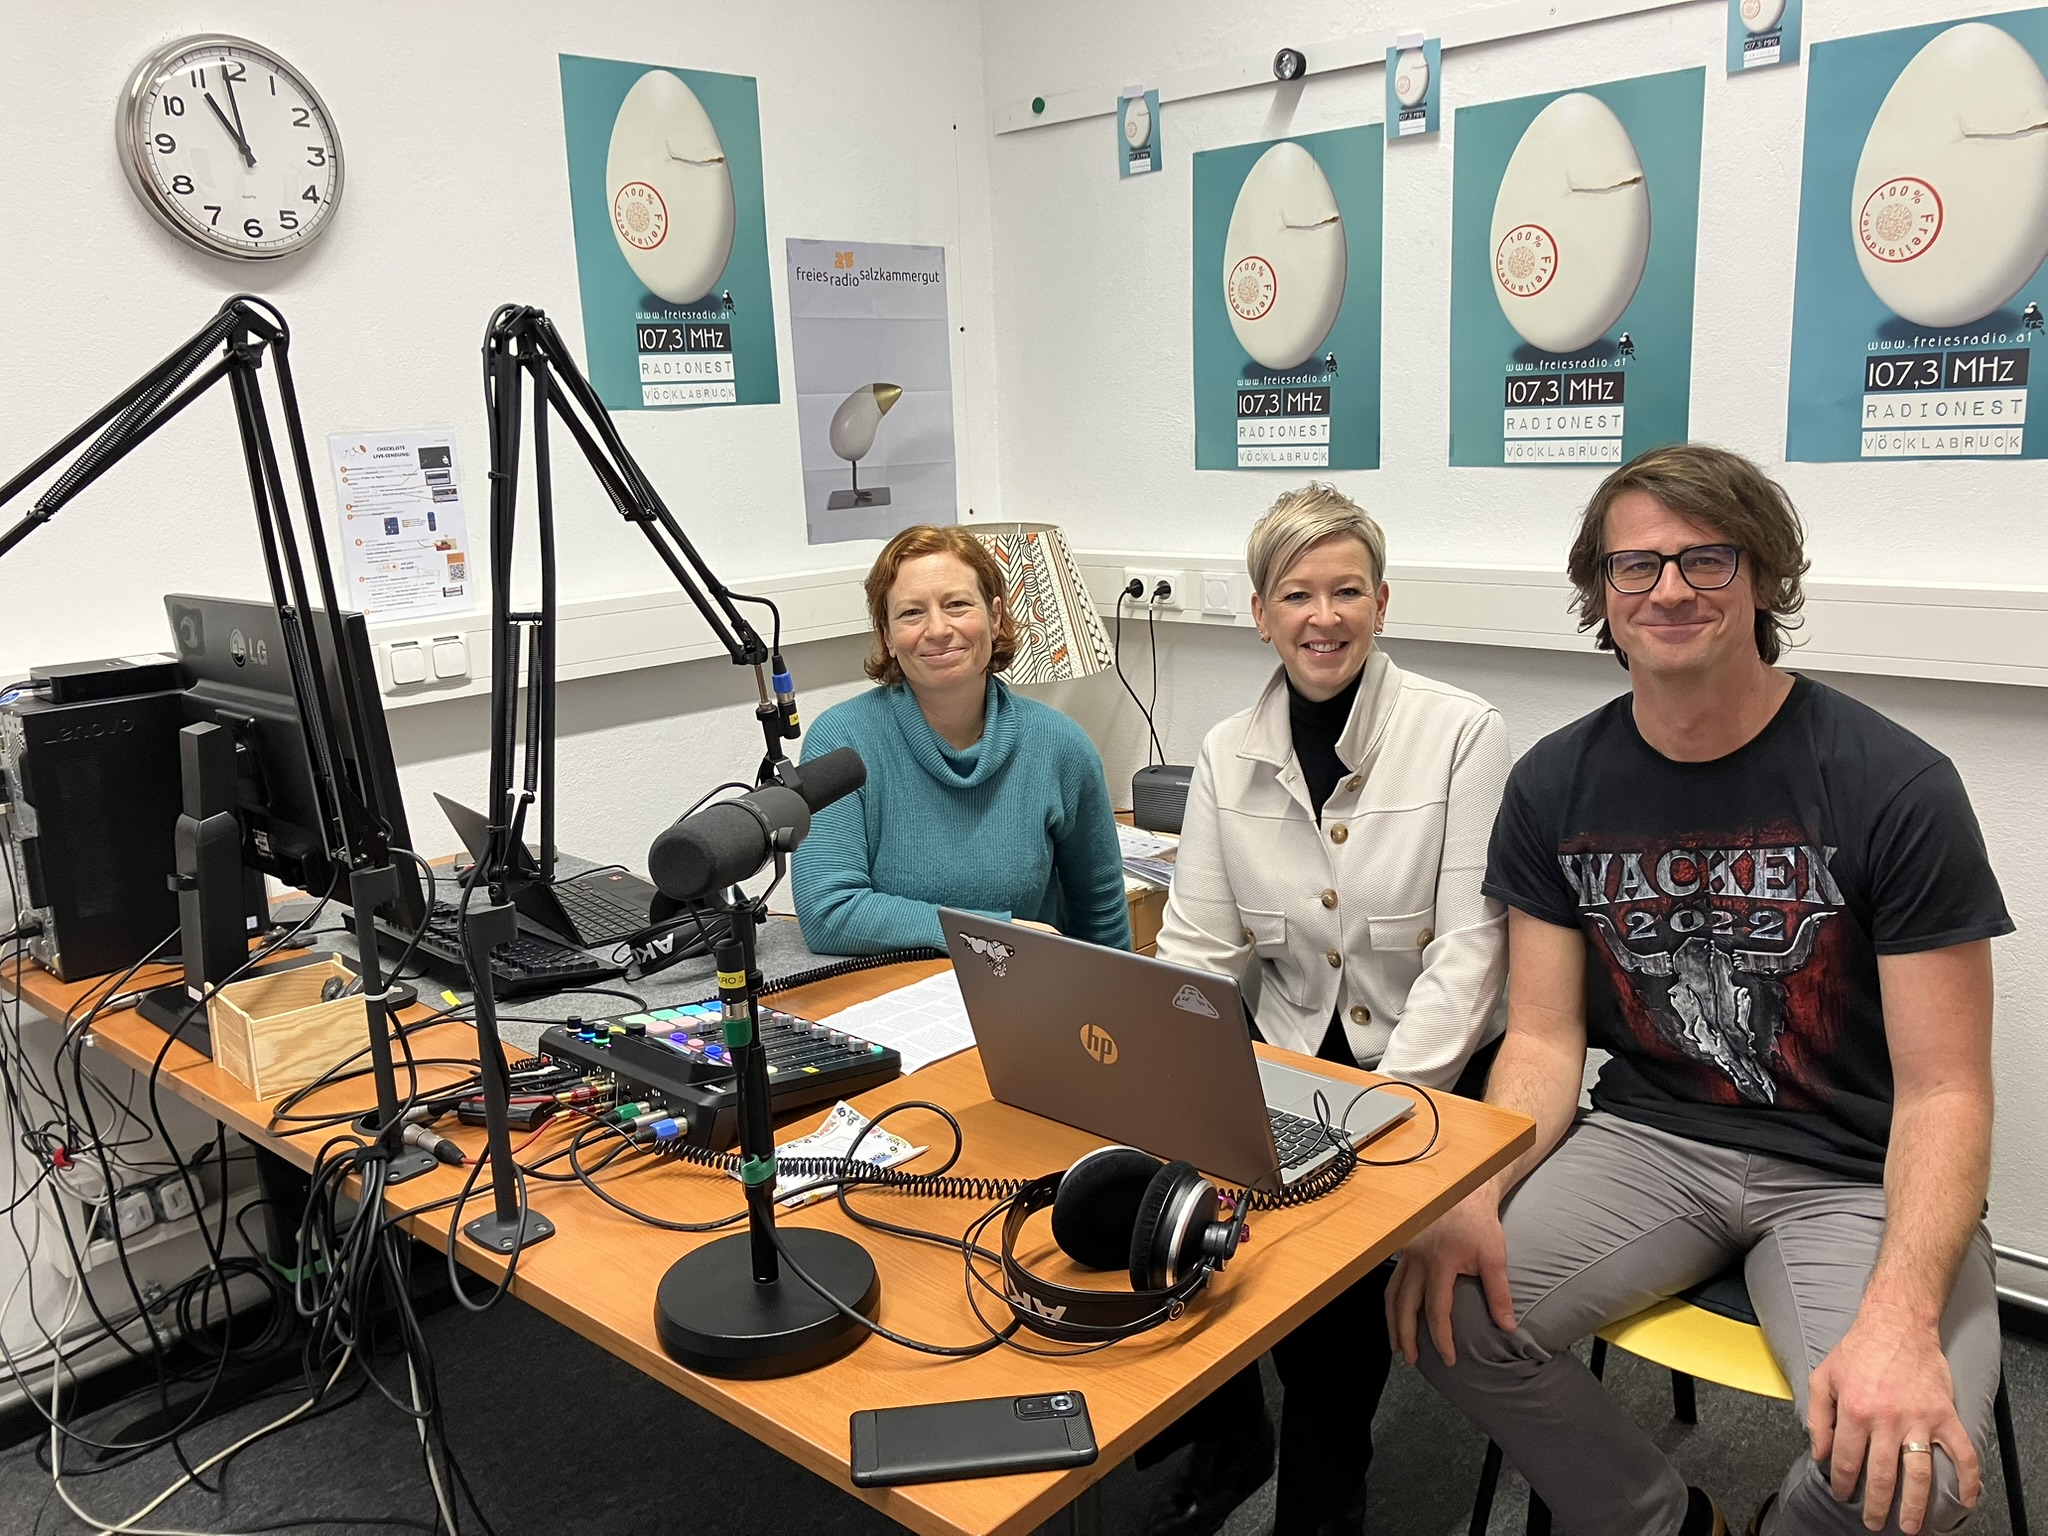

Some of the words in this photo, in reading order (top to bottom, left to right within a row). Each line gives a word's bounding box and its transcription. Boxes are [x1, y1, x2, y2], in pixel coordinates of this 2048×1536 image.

[190, 68, 206, 89] 11
[269, 75, 276, 96] 1
[163, 95, 185, 117] 10
[291, 107, 311, 128] 2
[154, 133, 176, 154] 9
[306, 146, 326, 167] 3
[172, 174, 195, 195] 8
[301, 184, 320, 204] 4
[1880, 185, 1925, 204] 100%
[624, 188, 654, 205] 100%
[203, 205, 222, 226] 7
[279, 209, 299, 230] 5
[243, 218, 264, 238] 6
[1510, 231, 1544, 248] 100%
[834, 251, 854, 270] 25
[1239, 262, 1266, 277] 100%
[796, 266, 829, 282] freies
[830, 273, 860, 287] radio
[859, 266, 940, 286] salzkammergut
[635, 309, 730, 320] www.freiesradio.at
[639, 328, 684, 352] 107,3
[690, 328, 725, 348] MHz
[1867, 332, 2033, 351] www.freiesradio.at
[641, 360, 732, 375] RADIONEST
[1505, 357, 1626, 372] www.freiesradio.at
[1867, 359, 1939, 390] 107,3
[1952, 356, 2015, 384] MHz
[1236, 374, 1332, 386] www.freiesradio.at
[643, 387, 735, 400] VÖCKLABRUCK
[1506, 380, 1560, 406] 107,3
[1569, 377, 1615, 401] MHz
[1239, 393, 1280, 416] 107,3
[1287, 391, 1323, 413] MHz
[1866, 398, 2023, 419] RADIONEST
[1239, 424, 1328, 438] RADIONEST
[1506, 414, 1621, 430] RADIONEST
[1506, 443, 1620, 457] VÖCKLABRUCK
[1863, 433, 2021, 450] VÖCKLABRUCK
[1239, 450, 1328, 462] VÖCKLABRUCK
[248, 638, 268, 666] LG
[44, 718, 135, 745] Lenovo
[1557, 845, 1846, 908] WACKEN
[1623, 909, 1785, 941] 2022
[738, 975, 744, 983] 3
